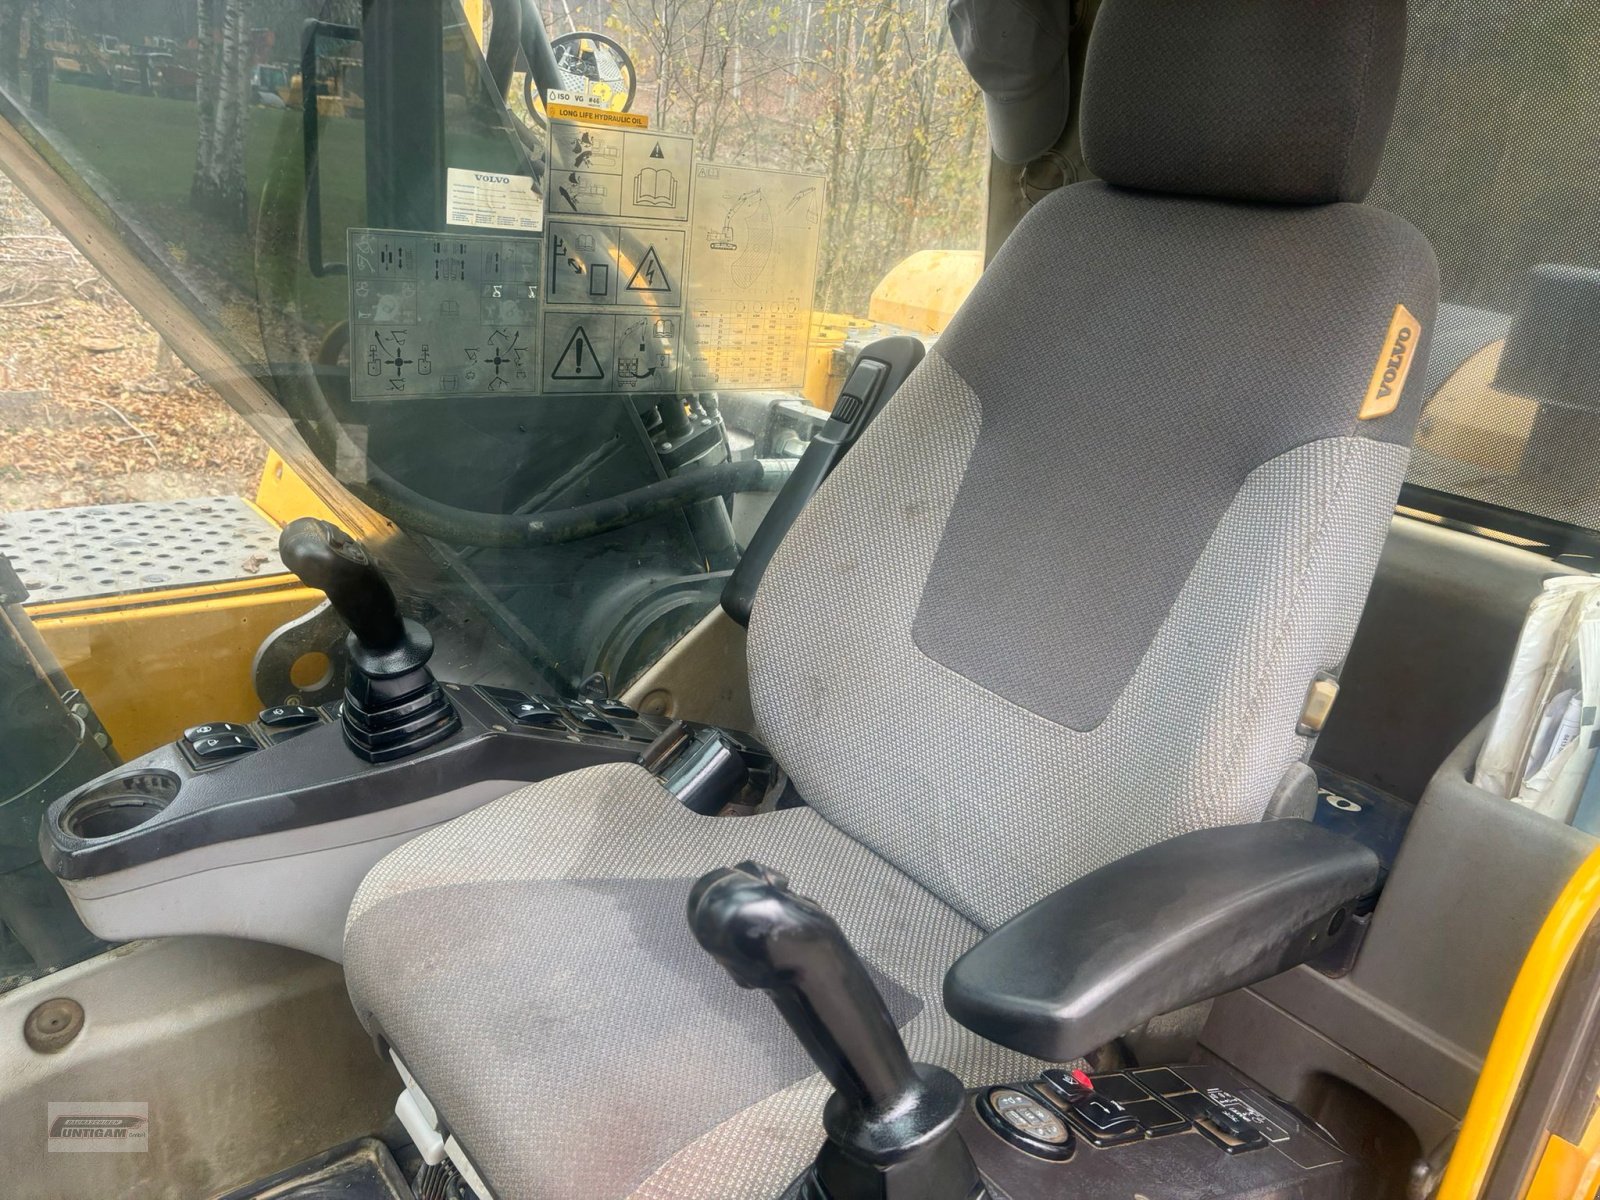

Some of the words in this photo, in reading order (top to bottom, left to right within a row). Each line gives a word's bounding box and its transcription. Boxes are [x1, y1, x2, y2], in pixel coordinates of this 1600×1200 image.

[557, 93, 570, 101] ISO
[559, 109, 578, 117] LONG
[580, 111, 593, 119] LIFE
[594, 114, 630, 124] HYDRAULIC
[631, 117, 643, 125] OIL
[474, 174, 510, 184] VOLVO
[1376, 327, 1411, 400] VOLVO
